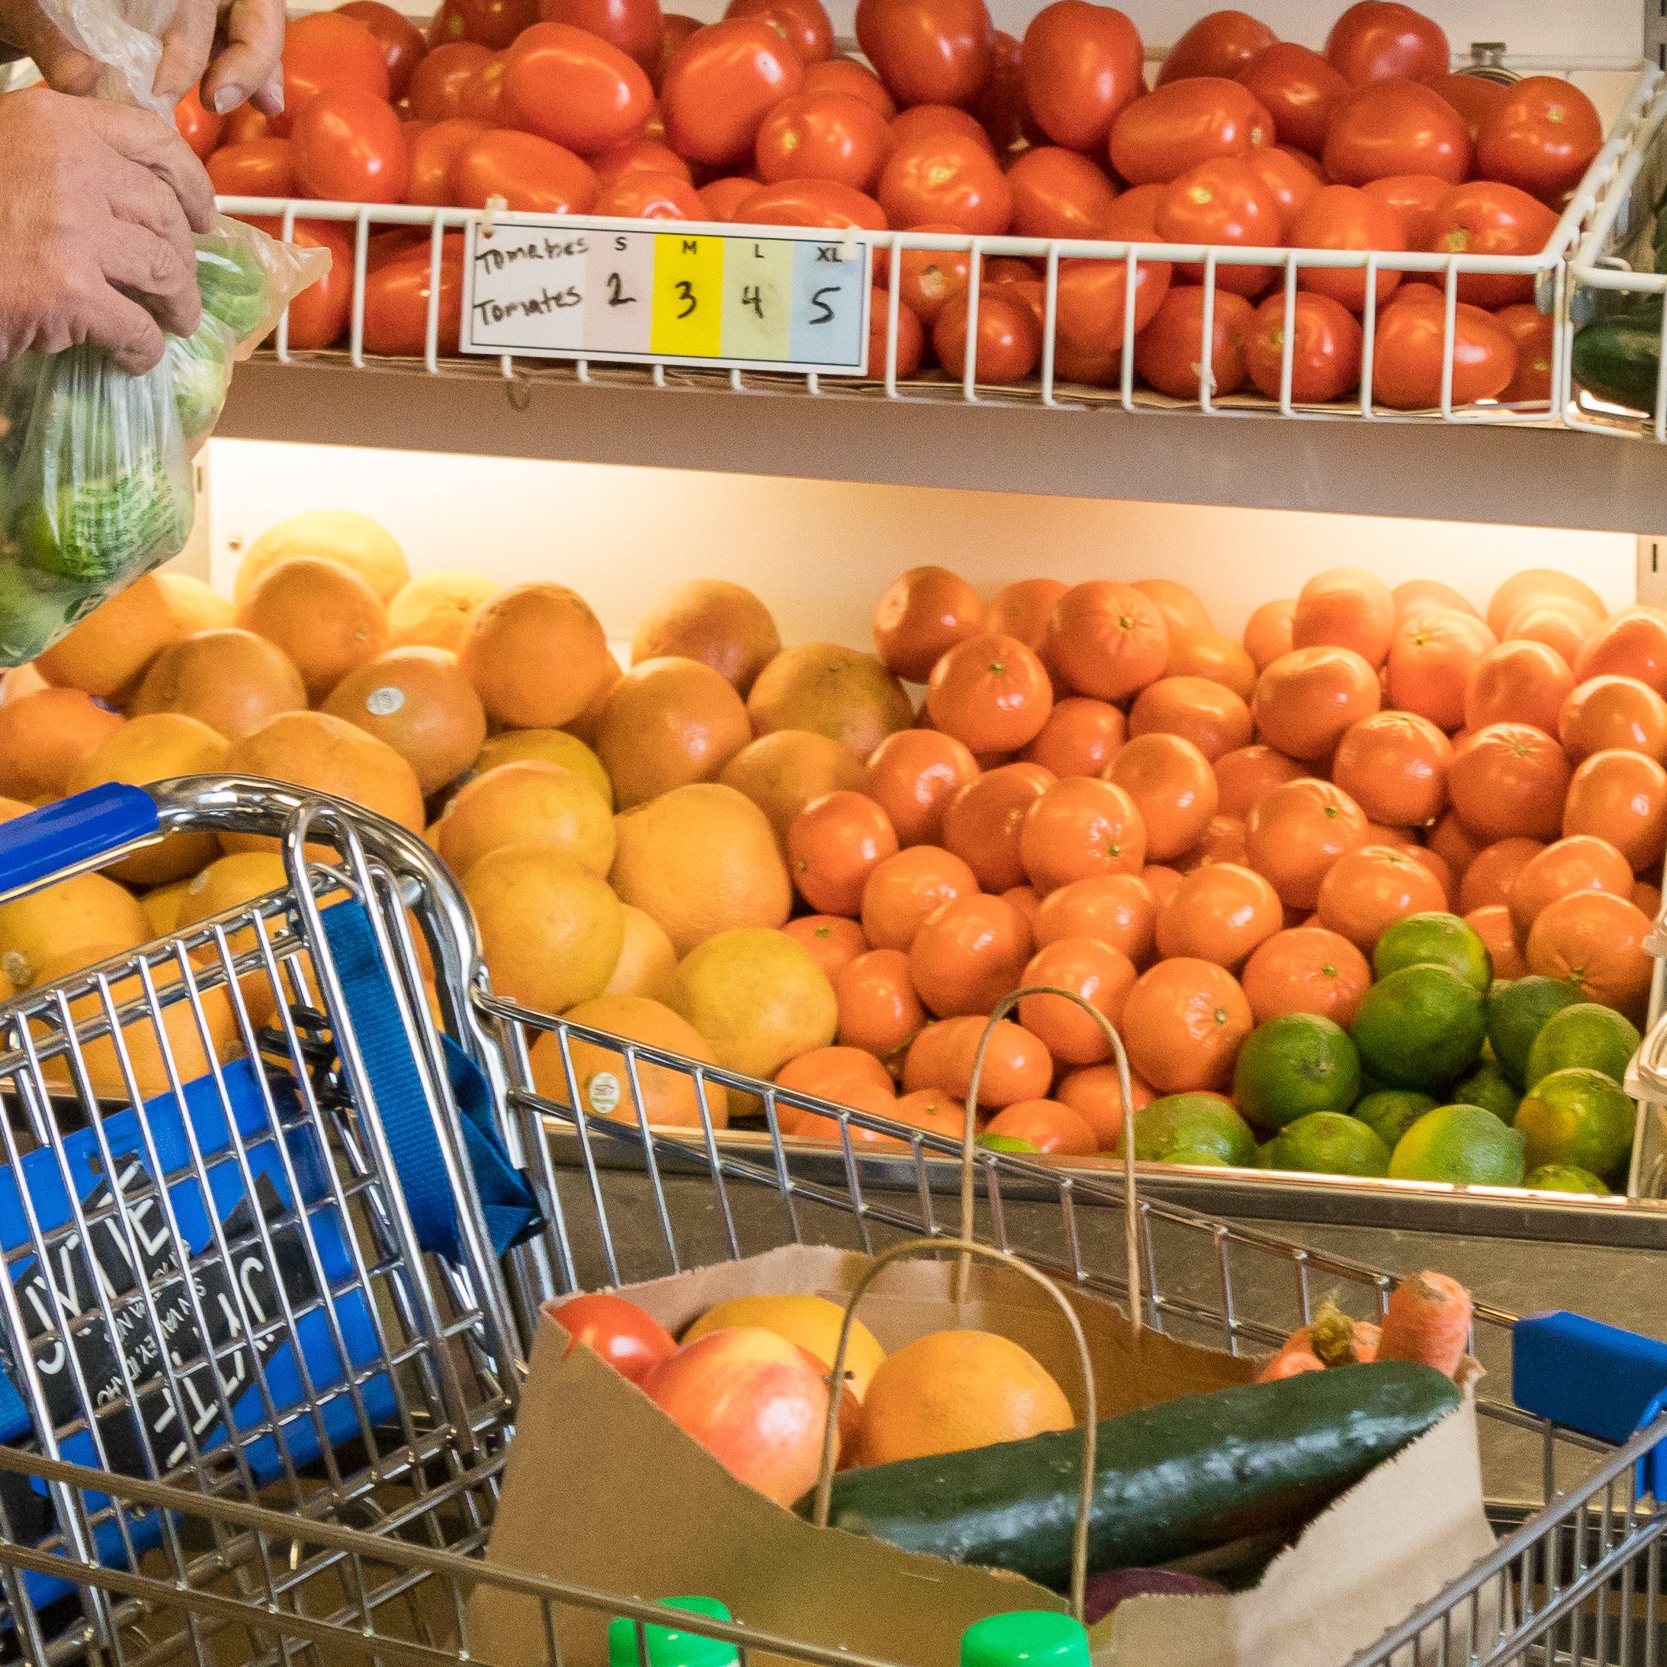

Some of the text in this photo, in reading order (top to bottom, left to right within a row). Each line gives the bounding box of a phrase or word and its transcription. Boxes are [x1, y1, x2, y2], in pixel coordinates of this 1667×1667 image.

[615, 236, 628, 252] S
[683, 240, 698, 255] M
[754, 243, 765, 259] L
[816, 246, 844, 263] XL
[606, 272, 638, 307] 2
[675, 280, 698, 319] 3
[741, 285, 764, 319] 4
[809, 286, 842, 325] 5
